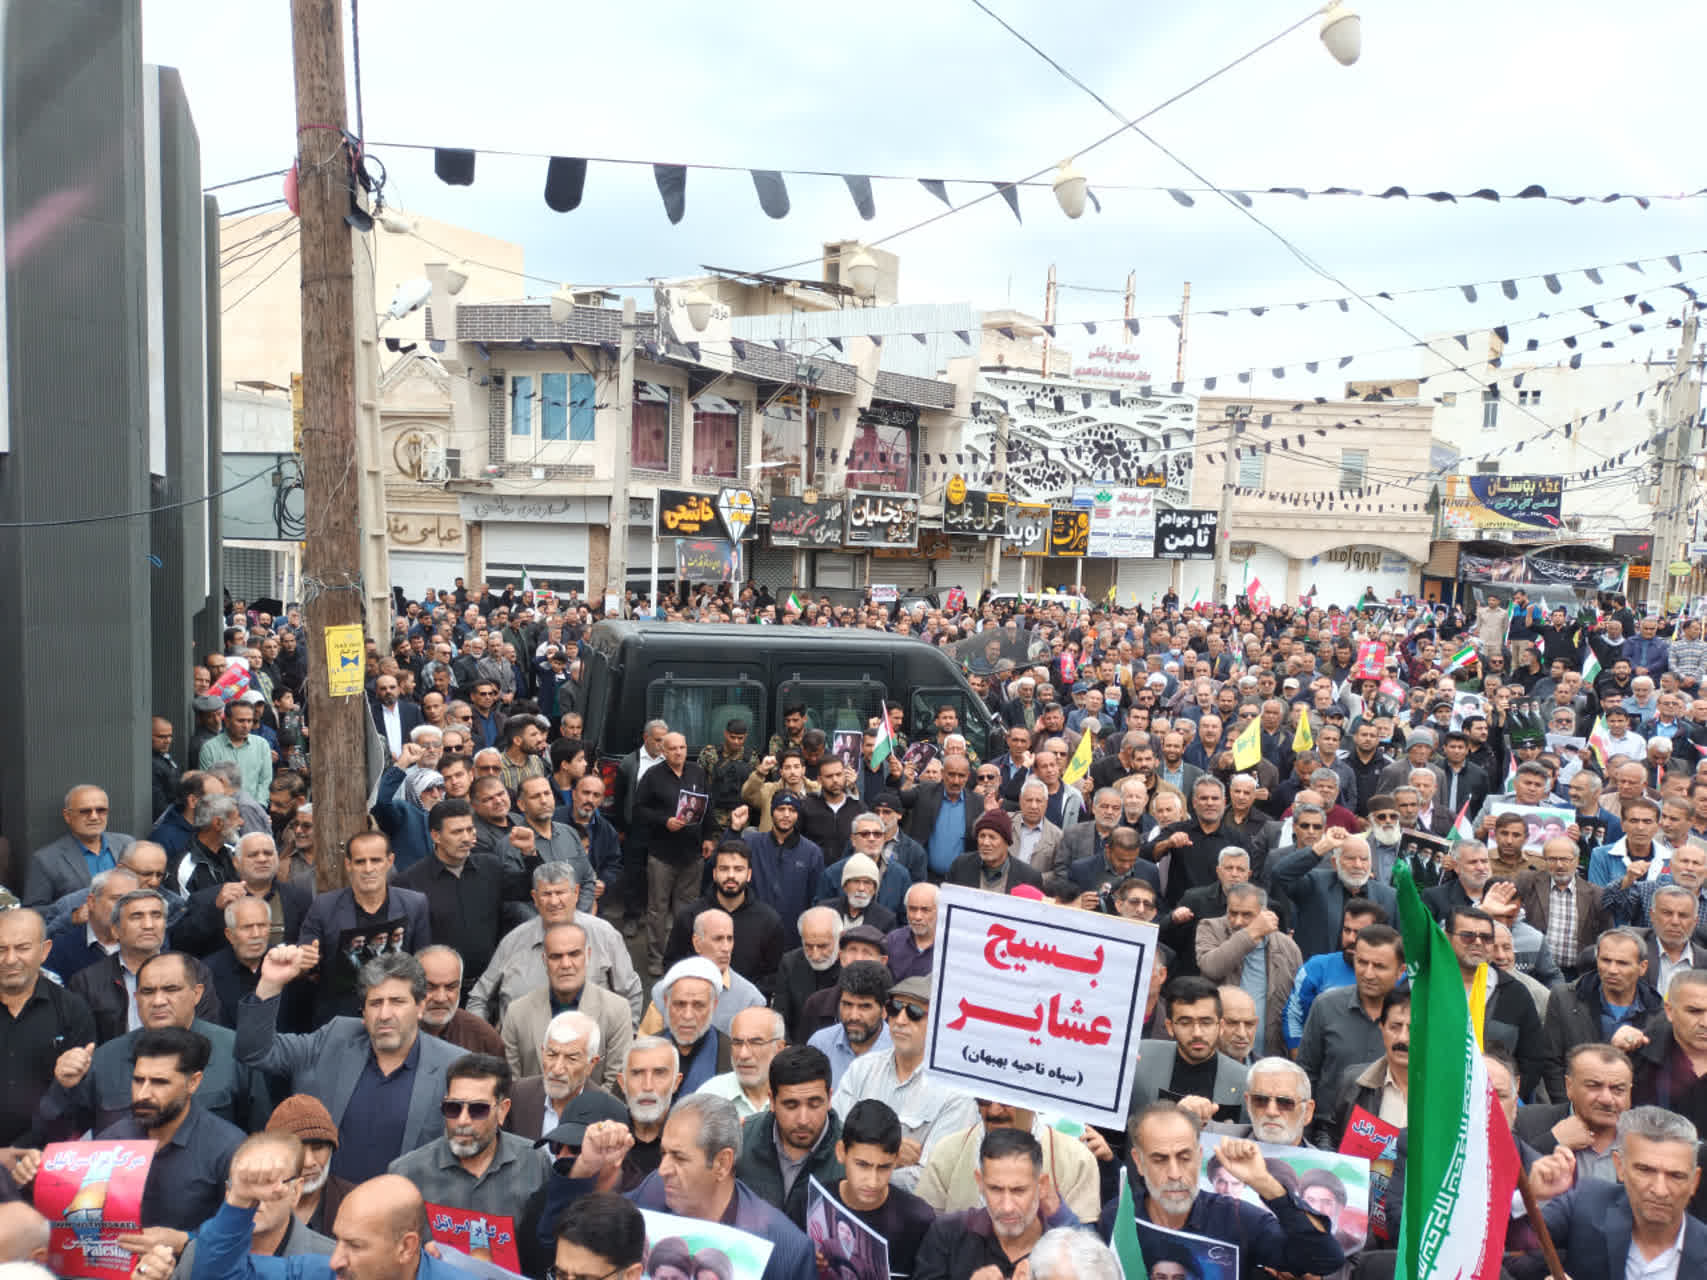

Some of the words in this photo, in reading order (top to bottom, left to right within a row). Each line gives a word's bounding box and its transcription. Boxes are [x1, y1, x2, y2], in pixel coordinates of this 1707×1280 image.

[1158, 512, 1191, 528] جواهر
[1192, 517, 1199, 528] و
[1200, 512, 1217, 526] طلا
[1004, 520, 1042, 546] نوید
[1164, 527, 1210, 551] ثامن
[983, 922, 1105, 989] بسیج
[946, 992, 1112, 1046] عشایر
[1010, 1057, 1045, 1076] ناحیه
